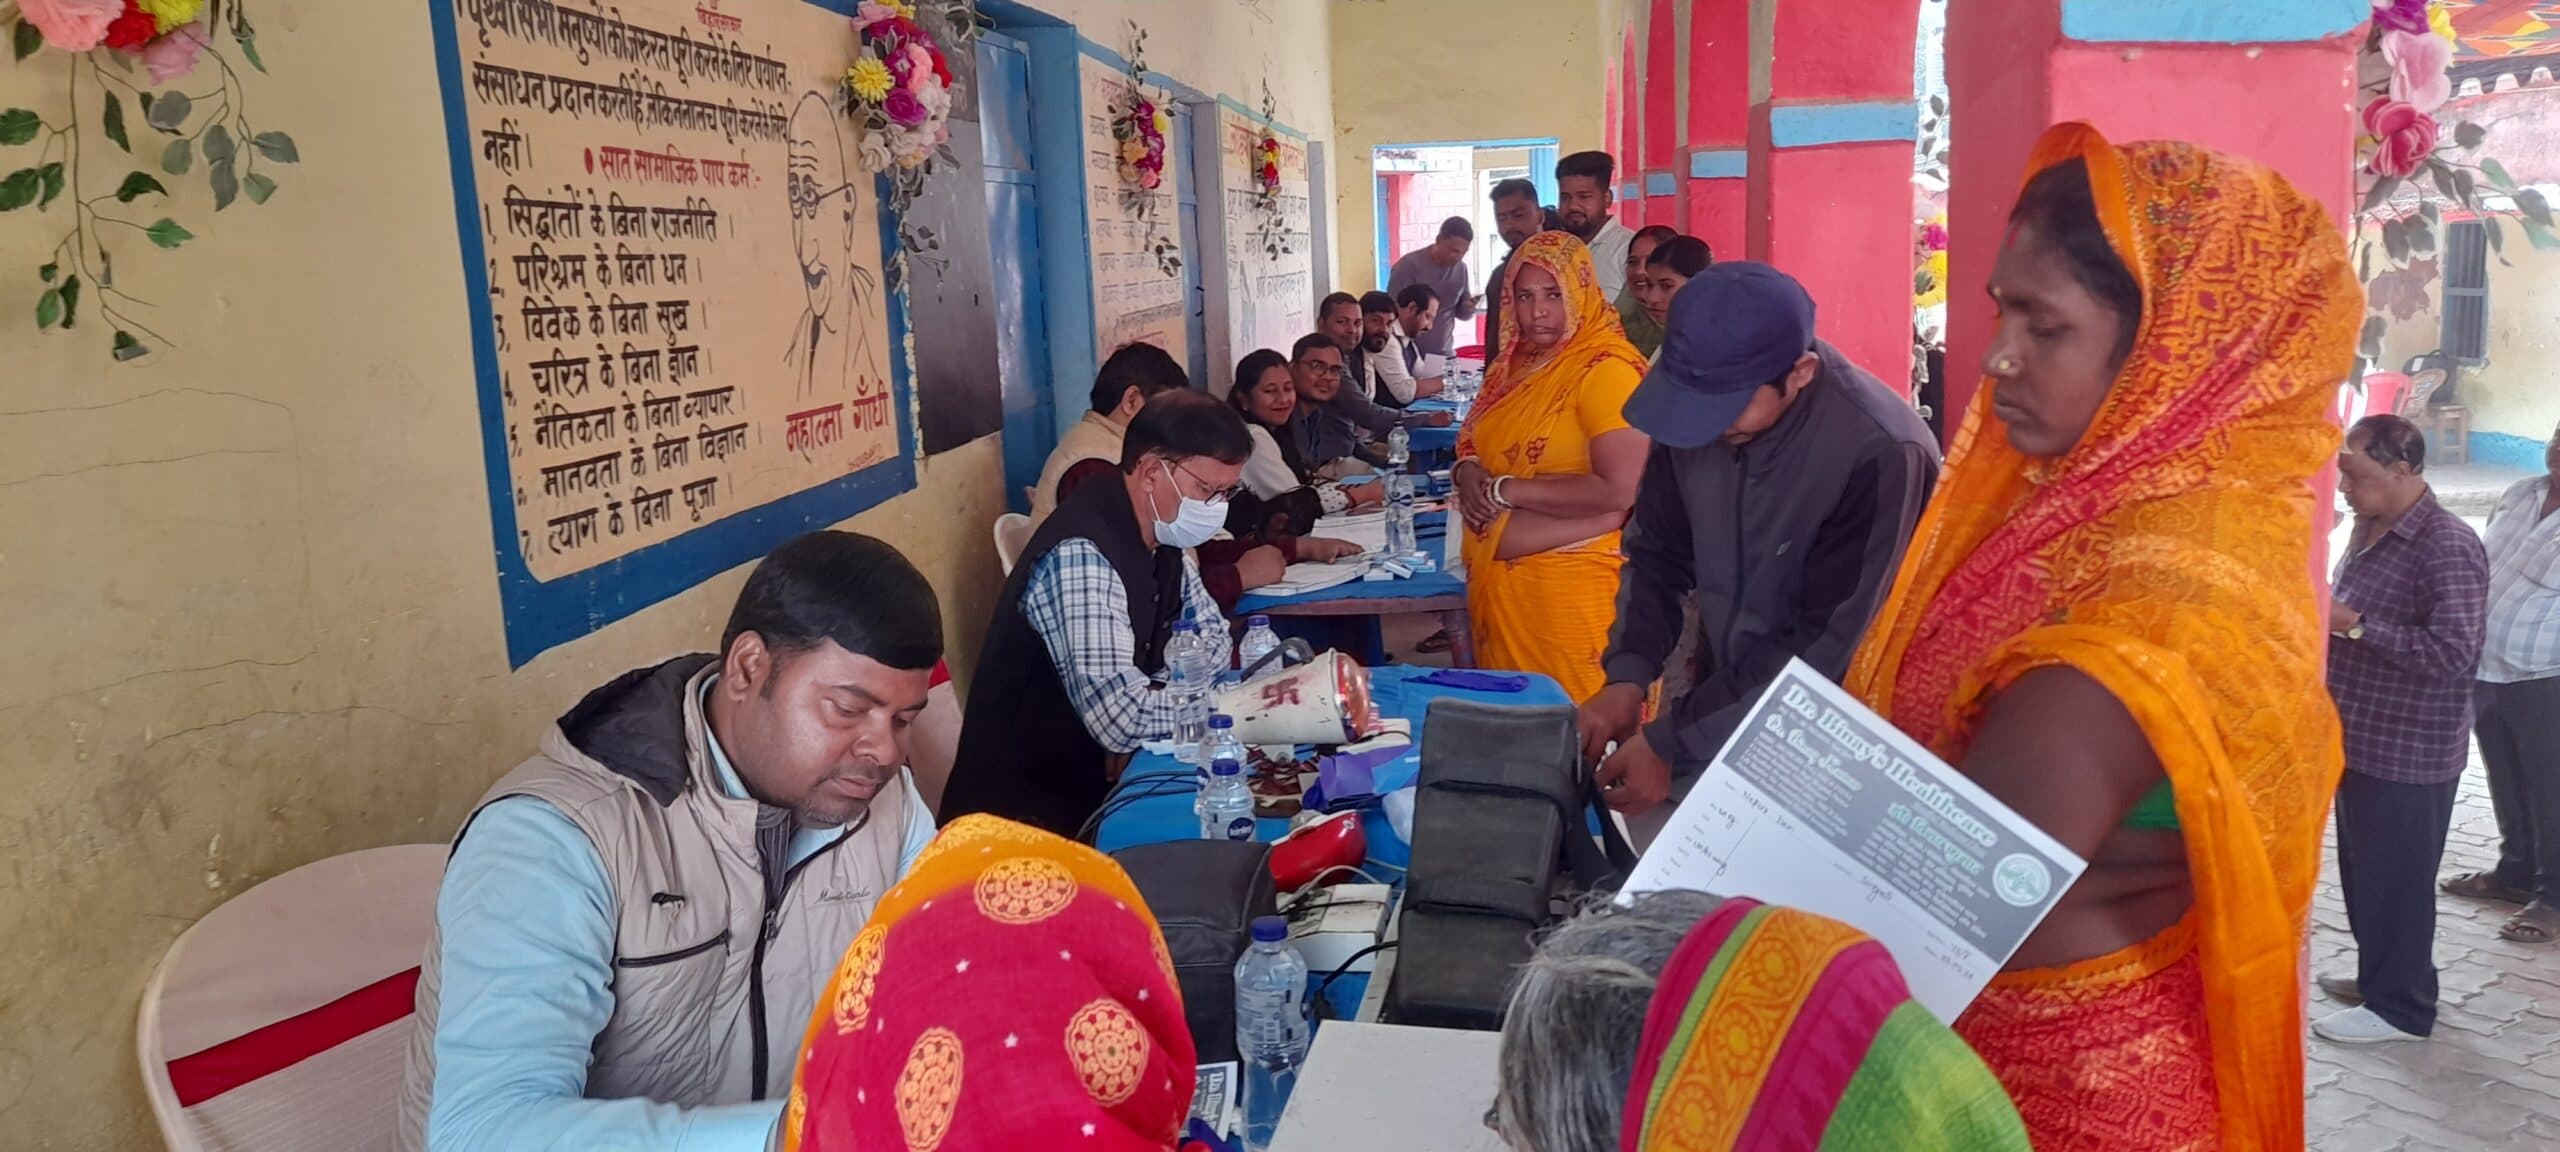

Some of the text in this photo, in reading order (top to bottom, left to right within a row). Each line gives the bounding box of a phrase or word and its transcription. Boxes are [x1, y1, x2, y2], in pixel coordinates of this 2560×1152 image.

[669, 26, 694, 88] पूरी
[472, 51, 545, 109] संसाधन
[547, 75, 597, 120] प्रदान
[718, 97, 738, 144] पूरी
[600, 146, 632, 183] सात
[634, 143, 699, 185] सामाजिक
[699, 158, 725, 187] पाप
[587, 188, 606, 237] के
[607, 191, 649, 238] बिना
[651, 196, 718, 242] राजनीति
[512, 242, 587, 294] परिश्रम
[593, 243, 612, 289] के
[615, 242, 655, 286] बिना
[660, 254, 688, 285] धन
[521, 294, 581, 342] विवेक
[584, 291, 605, 338] के
[608, 293, 649, 336] बिना
[656, 300, 690, 346] सुख
[528, 347, 591, 398] चरित्र
[596, 343, 615, 388] के
[620, 342, 661, 385] बिना
[667, 345, 700, 387] ज्ञान
[533, 398, 616, 451] नैतिकता
[621, 390, 639, 434] के
[642, 389, 681, 430] बिना
[684, 385, 736, 420] व्यापार
[541, 451, 622, 499] मानवता
[630, 437, 647, 476] के
[652, 432, 691, 473] बिना
[697, 422, 748, 467] विज्ञान
[547, 507, 600, 555] त्याग
[605, 492, 625, 537] के
[631, 485, 673, 532] बिना
[681, 476, 719, 523] पूजा
[1886, 758, 1999, 848] Healthcare
